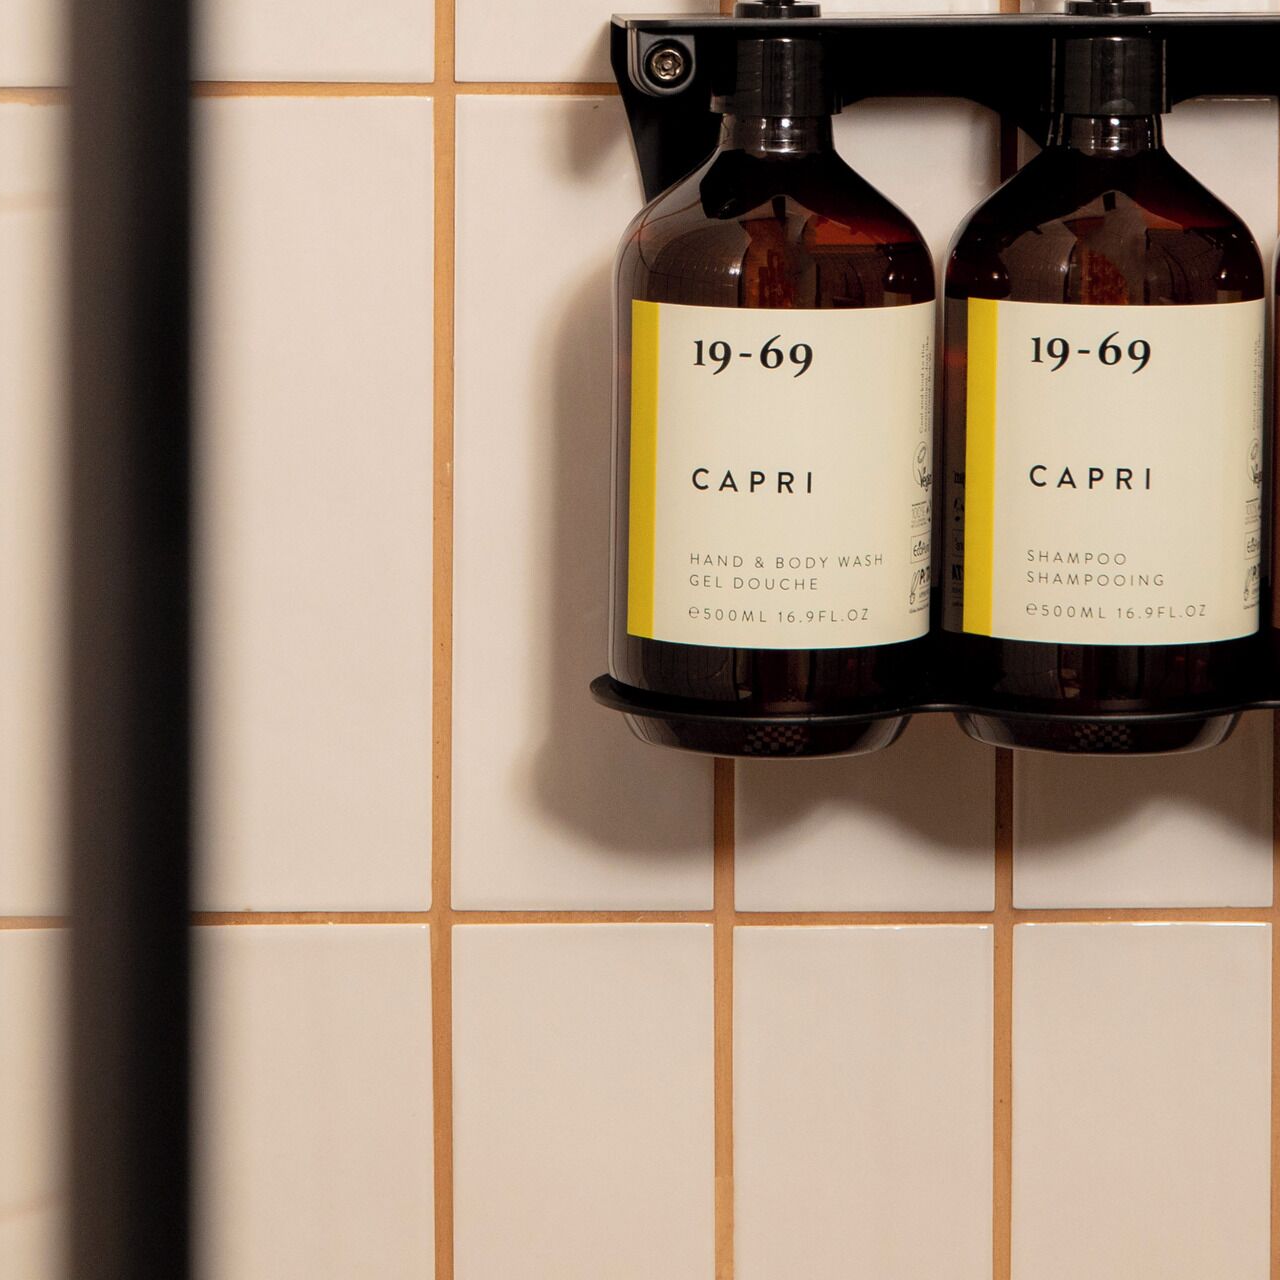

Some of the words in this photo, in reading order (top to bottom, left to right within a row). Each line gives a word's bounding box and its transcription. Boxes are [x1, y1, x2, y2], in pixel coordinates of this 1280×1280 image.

[692, 333, 814, 379] 19-69
[1029, 330, 1152, 373] 19-69
[691, 466, 813, 495] CAPRI
[1028, 464, 1152, 491] CAPRI
[689, 552, 744, 568] HAND
[754, 555, 765, 569] &
[775, 555, 829, 570] BODY
[837, 553, 883, 569] WASH
[1026, 548, 1127, 566] SHAMPOO
[688, 573, 723, 589] GEL
[733, 576, 818, 591] DOUCHE
[1026, 570, 1165, 587] SHAMPOOING
